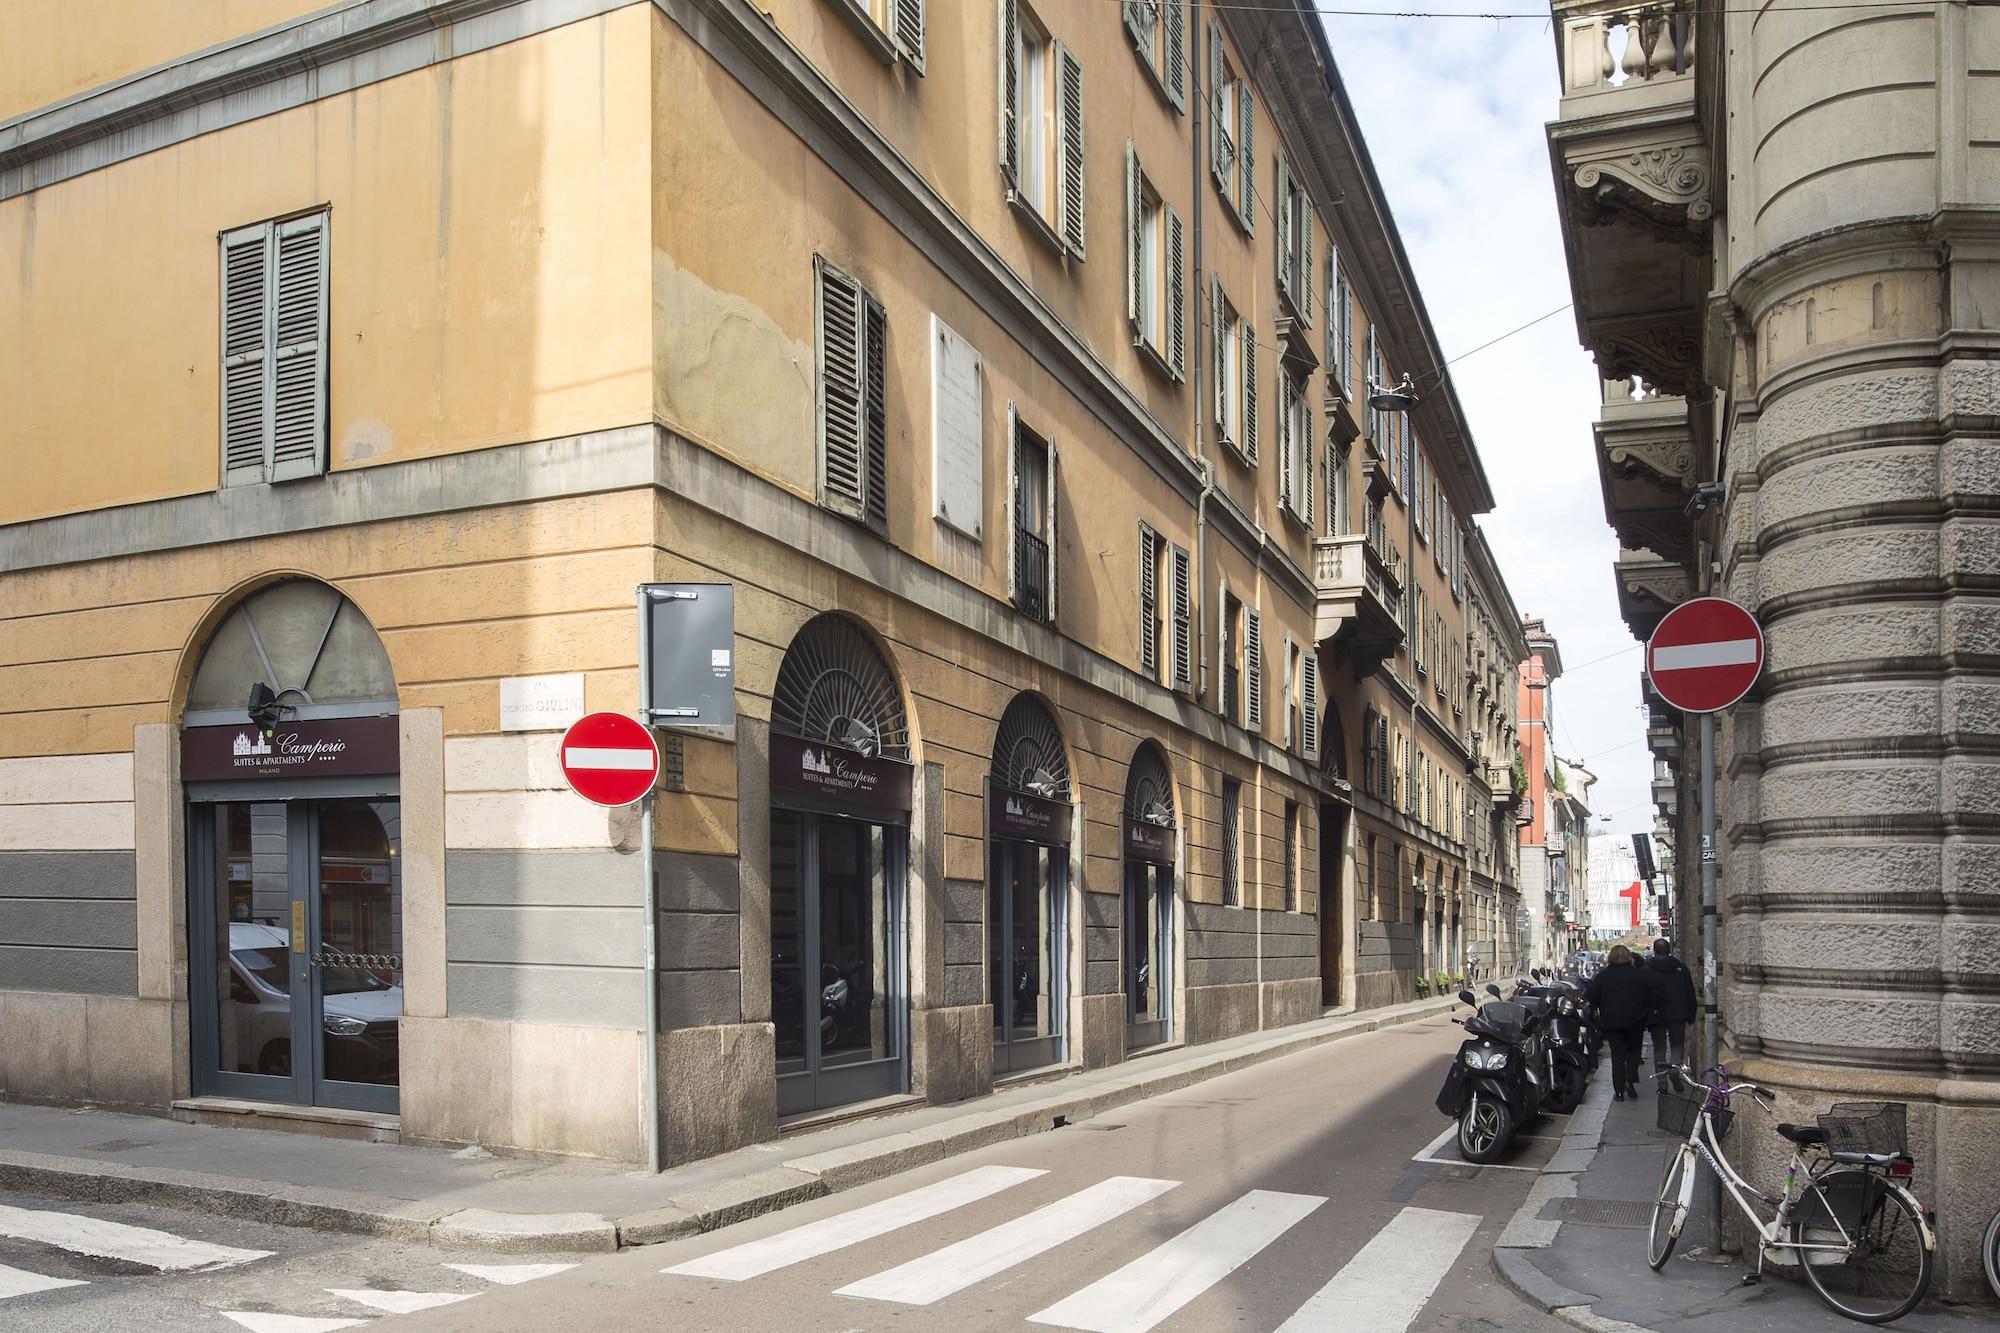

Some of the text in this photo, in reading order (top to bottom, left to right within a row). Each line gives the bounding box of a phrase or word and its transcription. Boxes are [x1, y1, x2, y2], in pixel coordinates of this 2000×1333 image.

[535, 697, 583, 712] GIULINI
[276, 732, 347, 762] Camperio
[233, 755, 306, 767] SUITES & APARTMENTS
[259, 767, 280, 775] MILANO
[833, 757, 878, 788] Camperio
[1619, 881, 1642, 927] 1
